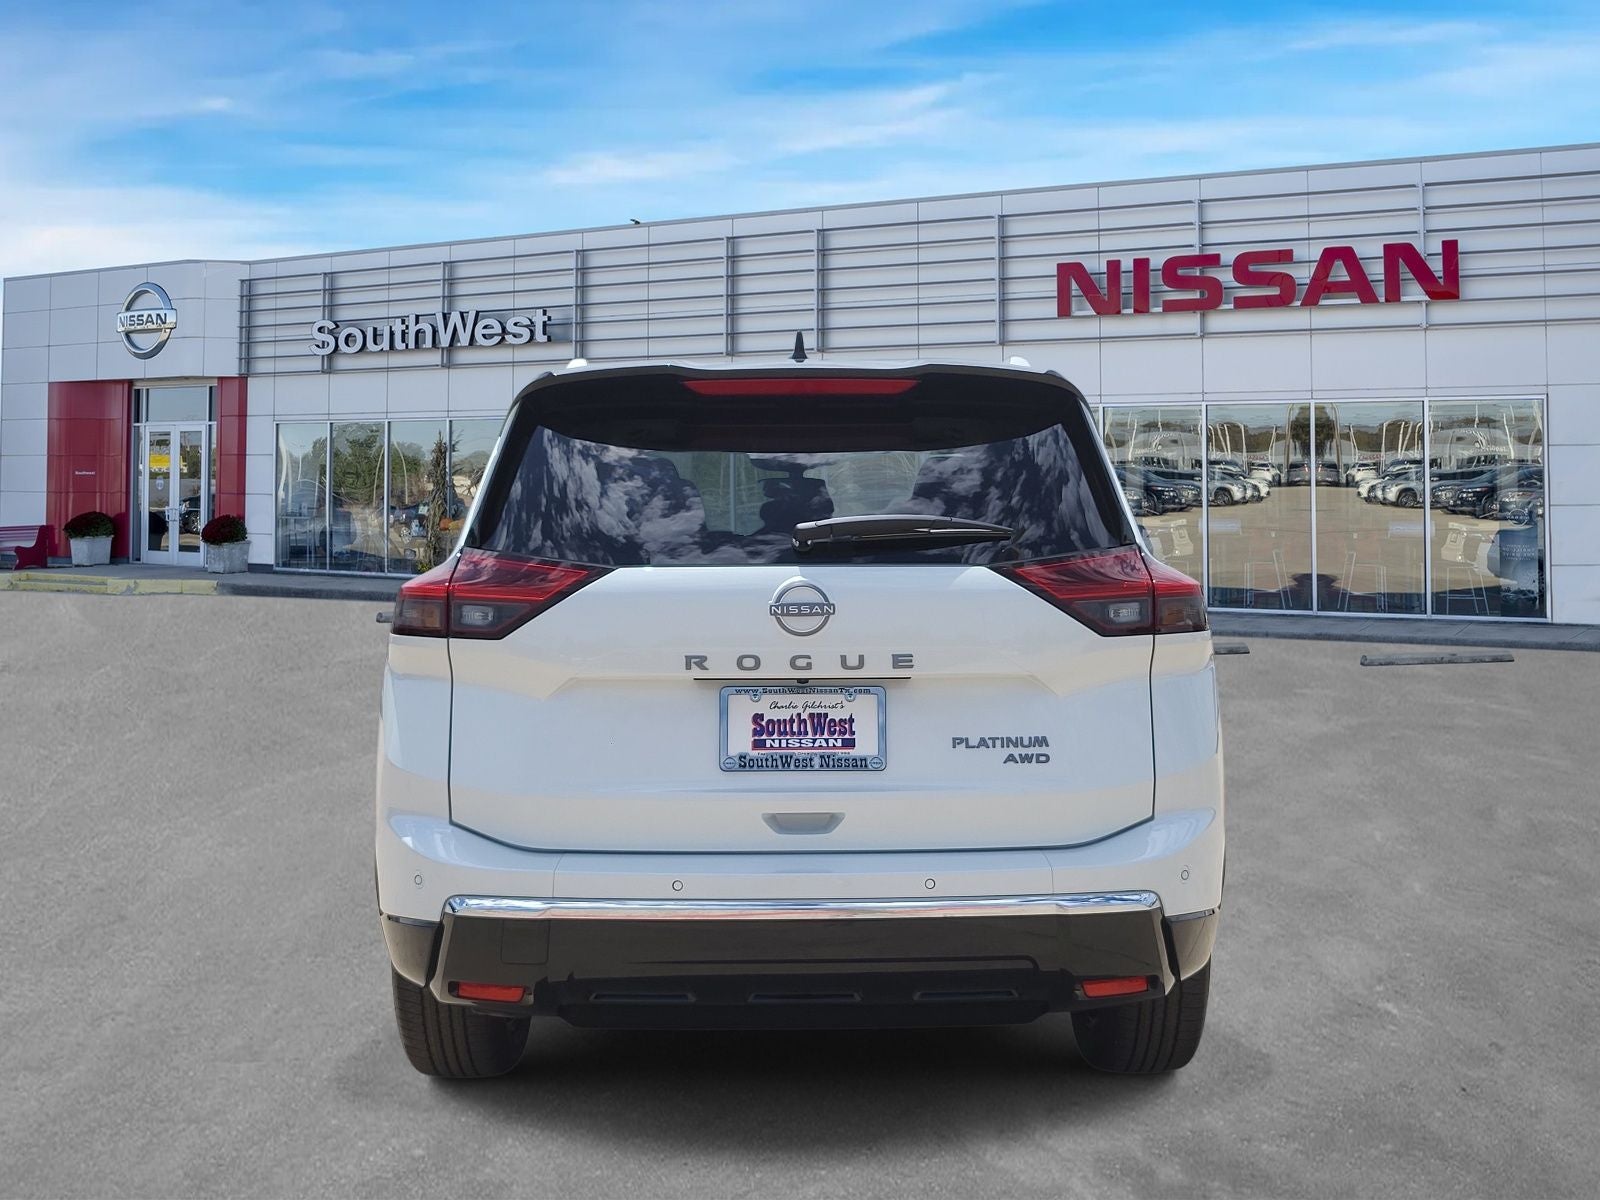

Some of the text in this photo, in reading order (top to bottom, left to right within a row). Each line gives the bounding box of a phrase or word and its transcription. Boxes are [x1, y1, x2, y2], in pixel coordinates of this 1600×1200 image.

[1057, 239, 1460, 317] NISSAN
[118, 312, 168, 328] NISSAN
[309, 308, 550, 356] SouthWest
[770, 604, 835, 614] NISSAN
[684, 653, 915, 671] ROGUE
[769, 700, 845, 713] Charlie Gilchrist's
[751, 712, 856, 738] SouthWest
[765, 738, 842, 748] NISSAN
[951, 735, 1050, 749] PLATINUM
[738, 755, 814, 769] SouthWest
[819, 755, 868, 769] Nissan
[1002, 753, 1051, 764] AWD
